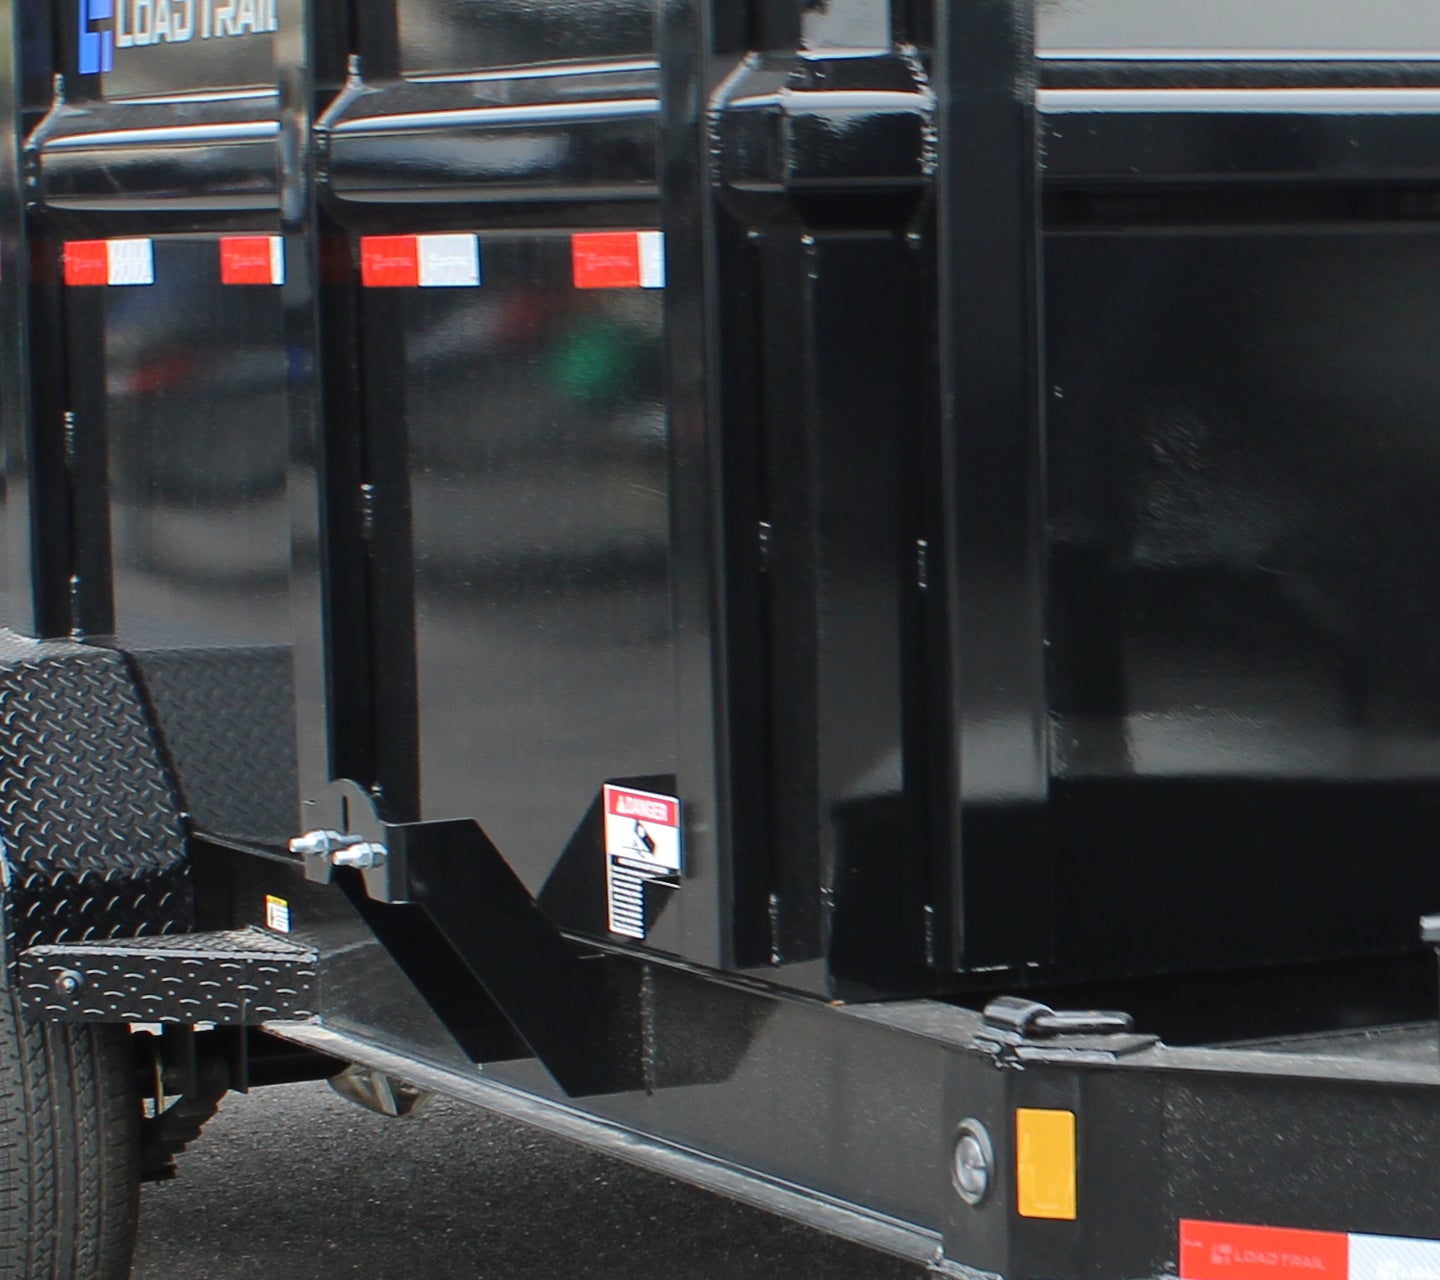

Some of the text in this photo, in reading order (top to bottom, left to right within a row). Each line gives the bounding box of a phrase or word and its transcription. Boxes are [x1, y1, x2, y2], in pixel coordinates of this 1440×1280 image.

[624, 796, 669, 822] DANGER
[1233, 1247, 1327, 1272] LOAD TRAIL
